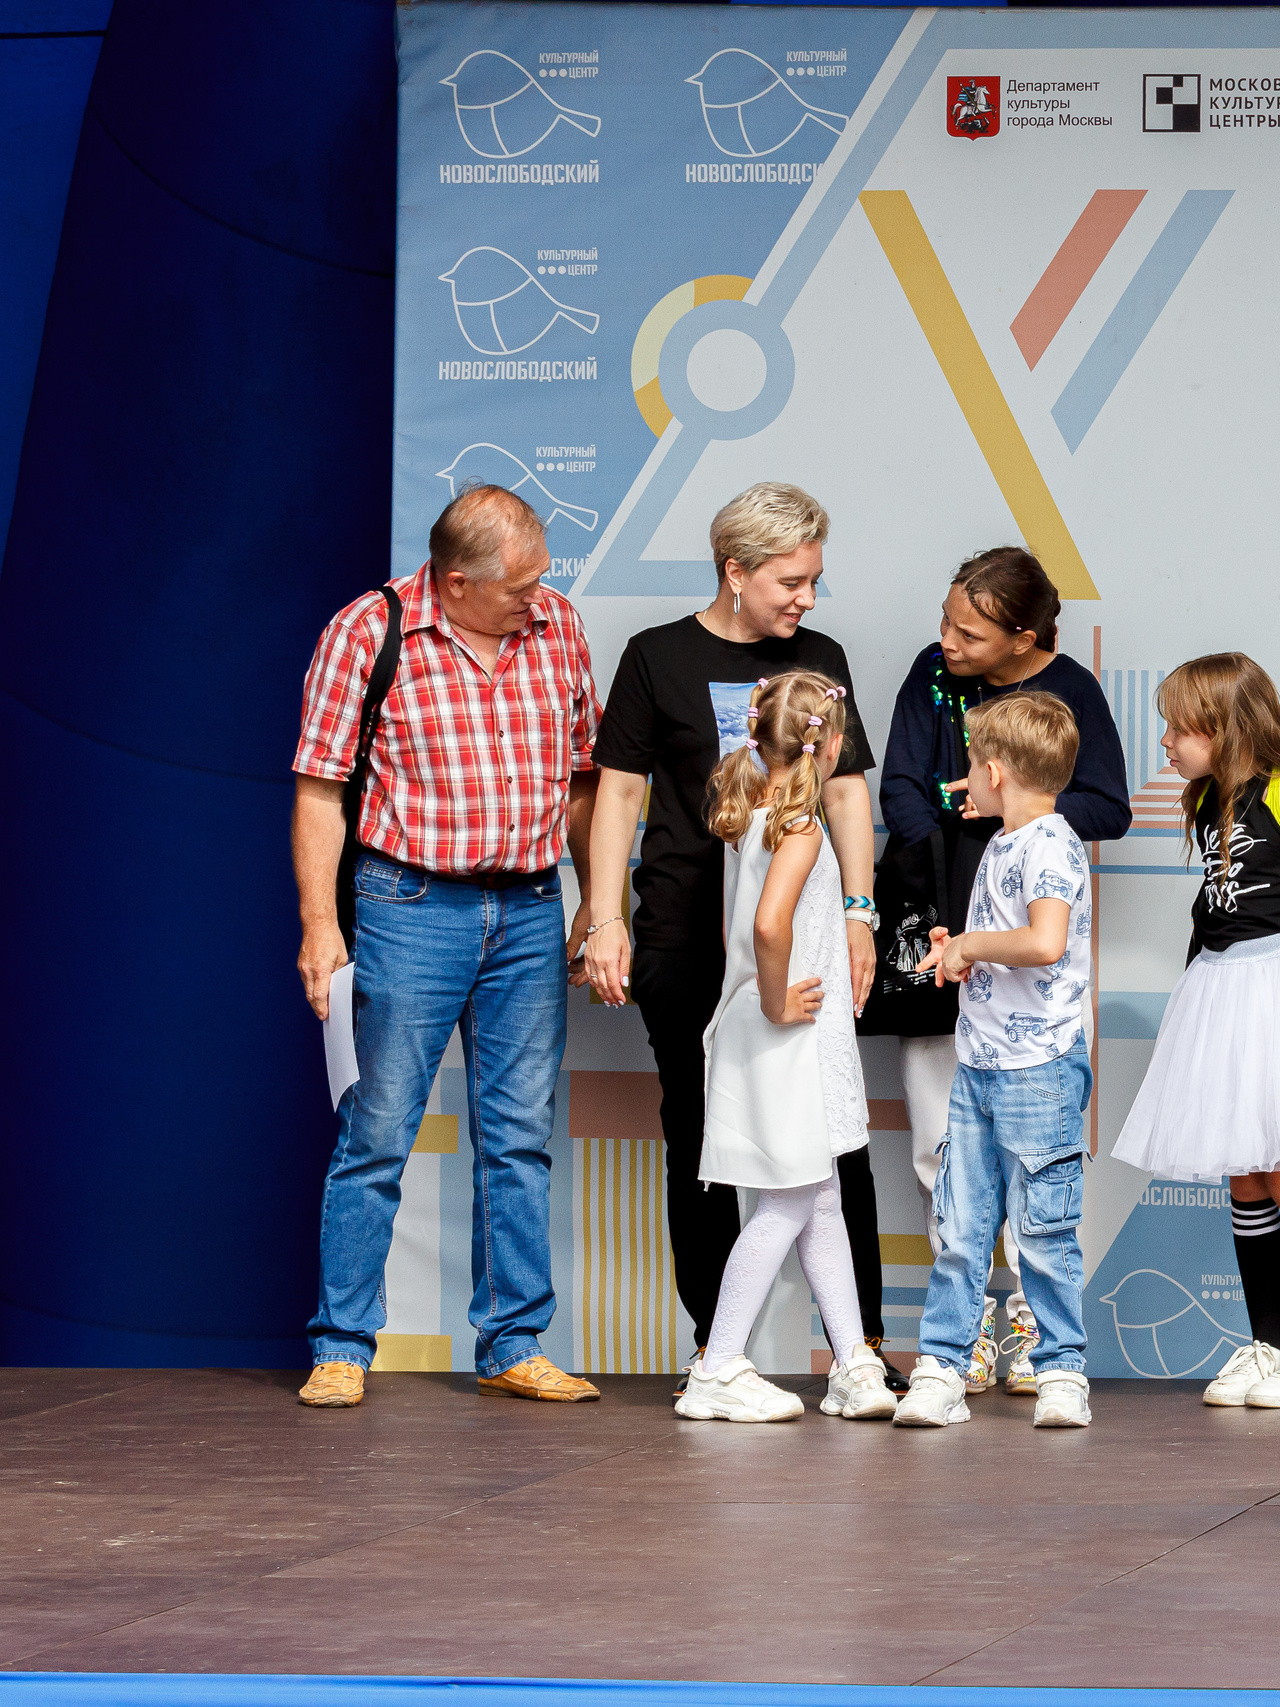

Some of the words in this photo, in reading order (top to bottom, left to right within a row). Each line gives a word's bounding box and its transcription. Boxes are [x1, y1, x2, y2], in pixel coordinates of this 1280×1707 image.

[538, 50, 599, 64] КУЛЬТУРНЫЙ
[786, 48, 847, 63] КУЛЬТУРНЫЙ
[568, 66, 599, 79] ЦЕНТР
[816, 64, 847, 78] ЦЕНТР
[1006, 79, 1101, 95] Департамент
[1006, 98, 1071, 113] культуры
[1006, 115, 1055, 129] города
[1058, 113, 1114, 128] Москвы
[439, 159, 600, 186] НОВОСЛОБОДСКИЙ
[537, 247, 598, 262] КУЛЬТУРНЫЙ
[567, 263, 598, 277] ЦЕНТР
[438, 357, 598, 383] НОВОСЛОБОДСКИЙ
[535, 444, 597, 458] КУЛЬТУРНЫЙ
[566, 460, 596, 474] ЦЕНТР
[1139, 1186, 1232, 1210] ОСЛОБОДС
[1201, 1274, 1242, 1287] КУЛЬТУР
